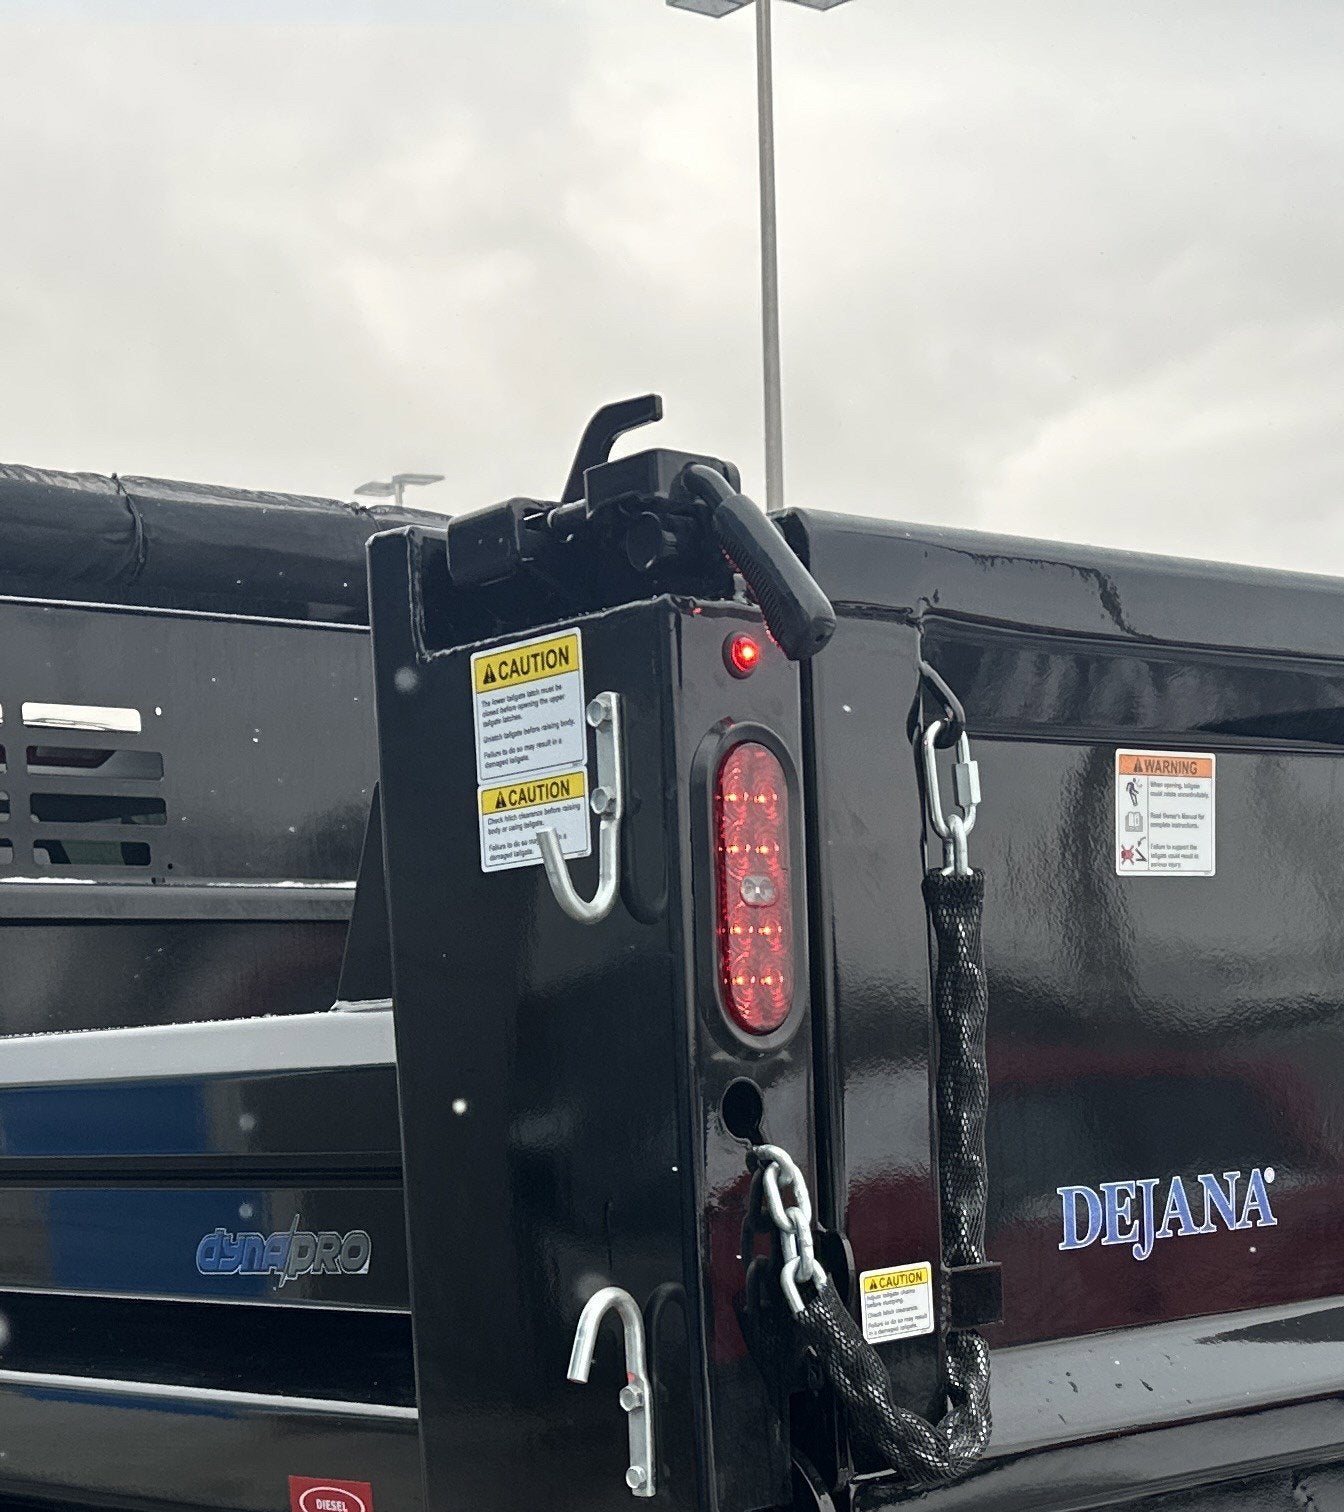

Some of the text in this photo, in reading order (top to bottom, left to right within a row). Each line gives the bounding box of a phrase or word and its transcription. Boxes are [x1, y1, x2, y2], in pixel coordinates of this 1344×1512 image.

[498, 645, 569, 680] CAUTION
[1145, 759, 1197, 774] WARNING
[509, 779, 570, 806] CAUTION
[1057, 1168, 1277, 1261] DEJANA
[879, 1271, 922, 1288] CAUTION
[316, 1499, 348, 1512] DIESEL
